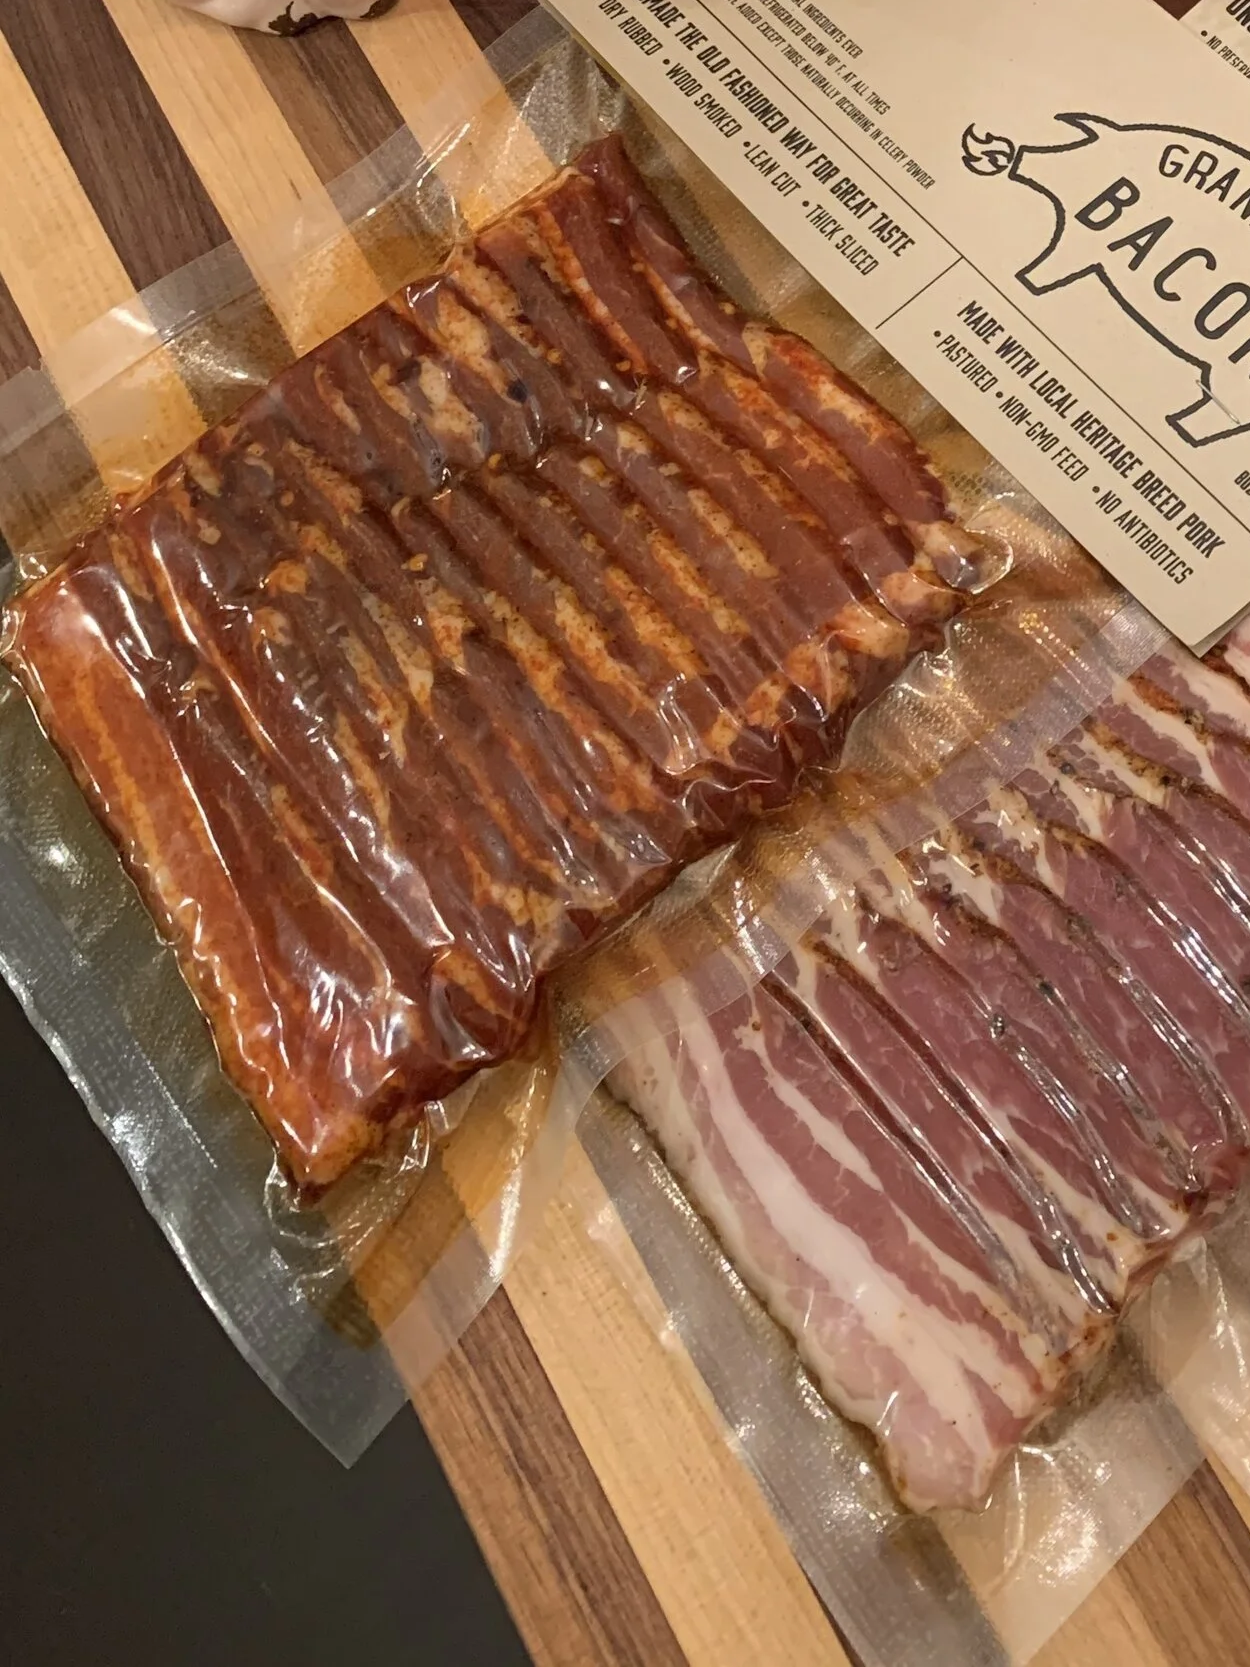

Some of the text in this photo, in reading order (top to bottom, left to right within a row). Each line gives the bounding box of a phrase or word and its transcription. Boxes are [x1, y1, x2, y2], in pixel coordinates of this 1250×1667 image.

[617, 15, 663, 56] RUBBED
[665, 62, 703, 97] WOOD
[693, 92, 742, 138] SMOKED
[743, 144, 780, 177] LEAN
[770, 171, 801, 196] CUT
[805, 203, 844, 241] THICK
[834, 234, 879, 275] SLICED
[674, 21, 708, 51] THE
[696, 45, 730, 73] OLD
[718, 67, 789, 133] FASHIONED
[779, 126, 817, 159] WAY
[805, 152, 840, 184] FOR
[829, 176, 878, 219] GREAT
[868, 211, 915, 257] TASTE
[735, 2, 762, 24] ADDED
[755, 21, 786, 47] EXCEPT
[780, 43, 806, 67] THOSE
[799, 62, 841, 99] NATURALLY
[834, 95, 875, 132] OCCURRING
[868, 127, 884, 140] IN
[877, 135, 908, 163] CELERY
[901, 158, 935, 190] POWDER
[800, 31, 829, 56] BELOW
[841, 71, 857, 83] AT
[850, 79, 869, 96] ALL
[864, 91, 890, 115] TIMES
[802, 3, 846, 43] INGREDIENTS
[840, 38, 863, 58] EVER
[936, 335, 1193, 584] PASTURED NON-GMO FEED NO ANTIBIOTICS
[956, 300, 1225, 558] MADE WITH LOCAL HERITAGE BREED PORK
